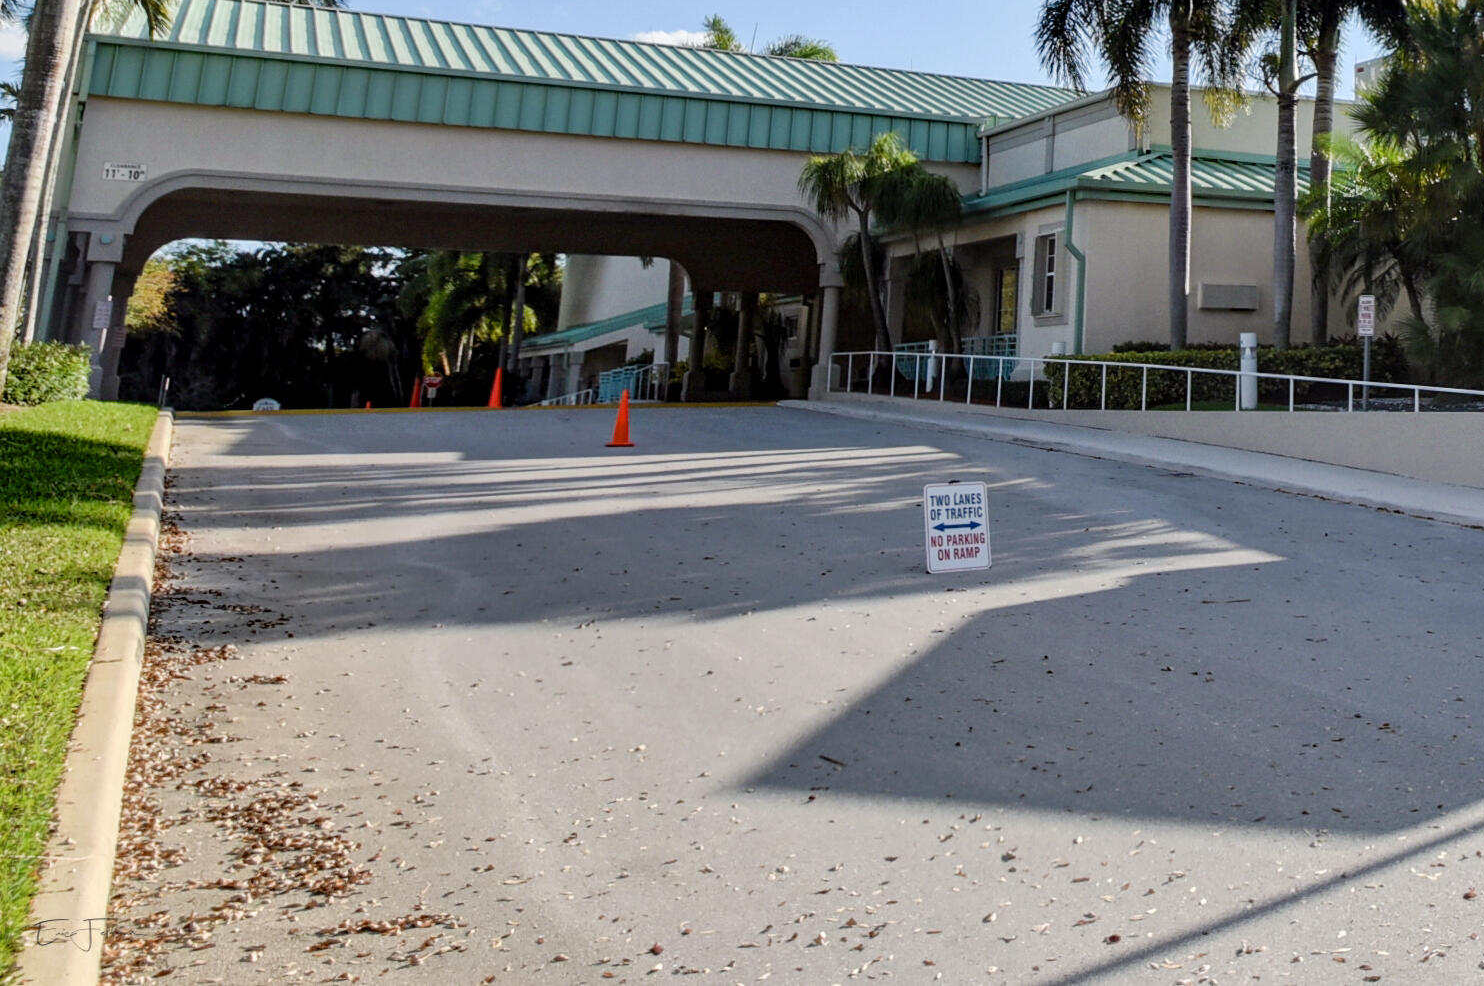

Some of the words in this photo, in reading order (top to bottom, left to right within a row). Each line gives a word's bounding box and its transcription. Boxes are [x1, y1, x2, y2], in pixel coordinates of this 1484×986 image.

[930, 495, 950, 506] TWO
[953, 493, 982, 505] LANES
[930, 509, 942, 521] OF
[945, 506, 983, 520] TRAFFIC
[930, 535, 943, 548] NO
[947, 532, 985, 546] PARKING
[937, 549, 951, 561] ON
[953, 546, 980, 560] RAMP
